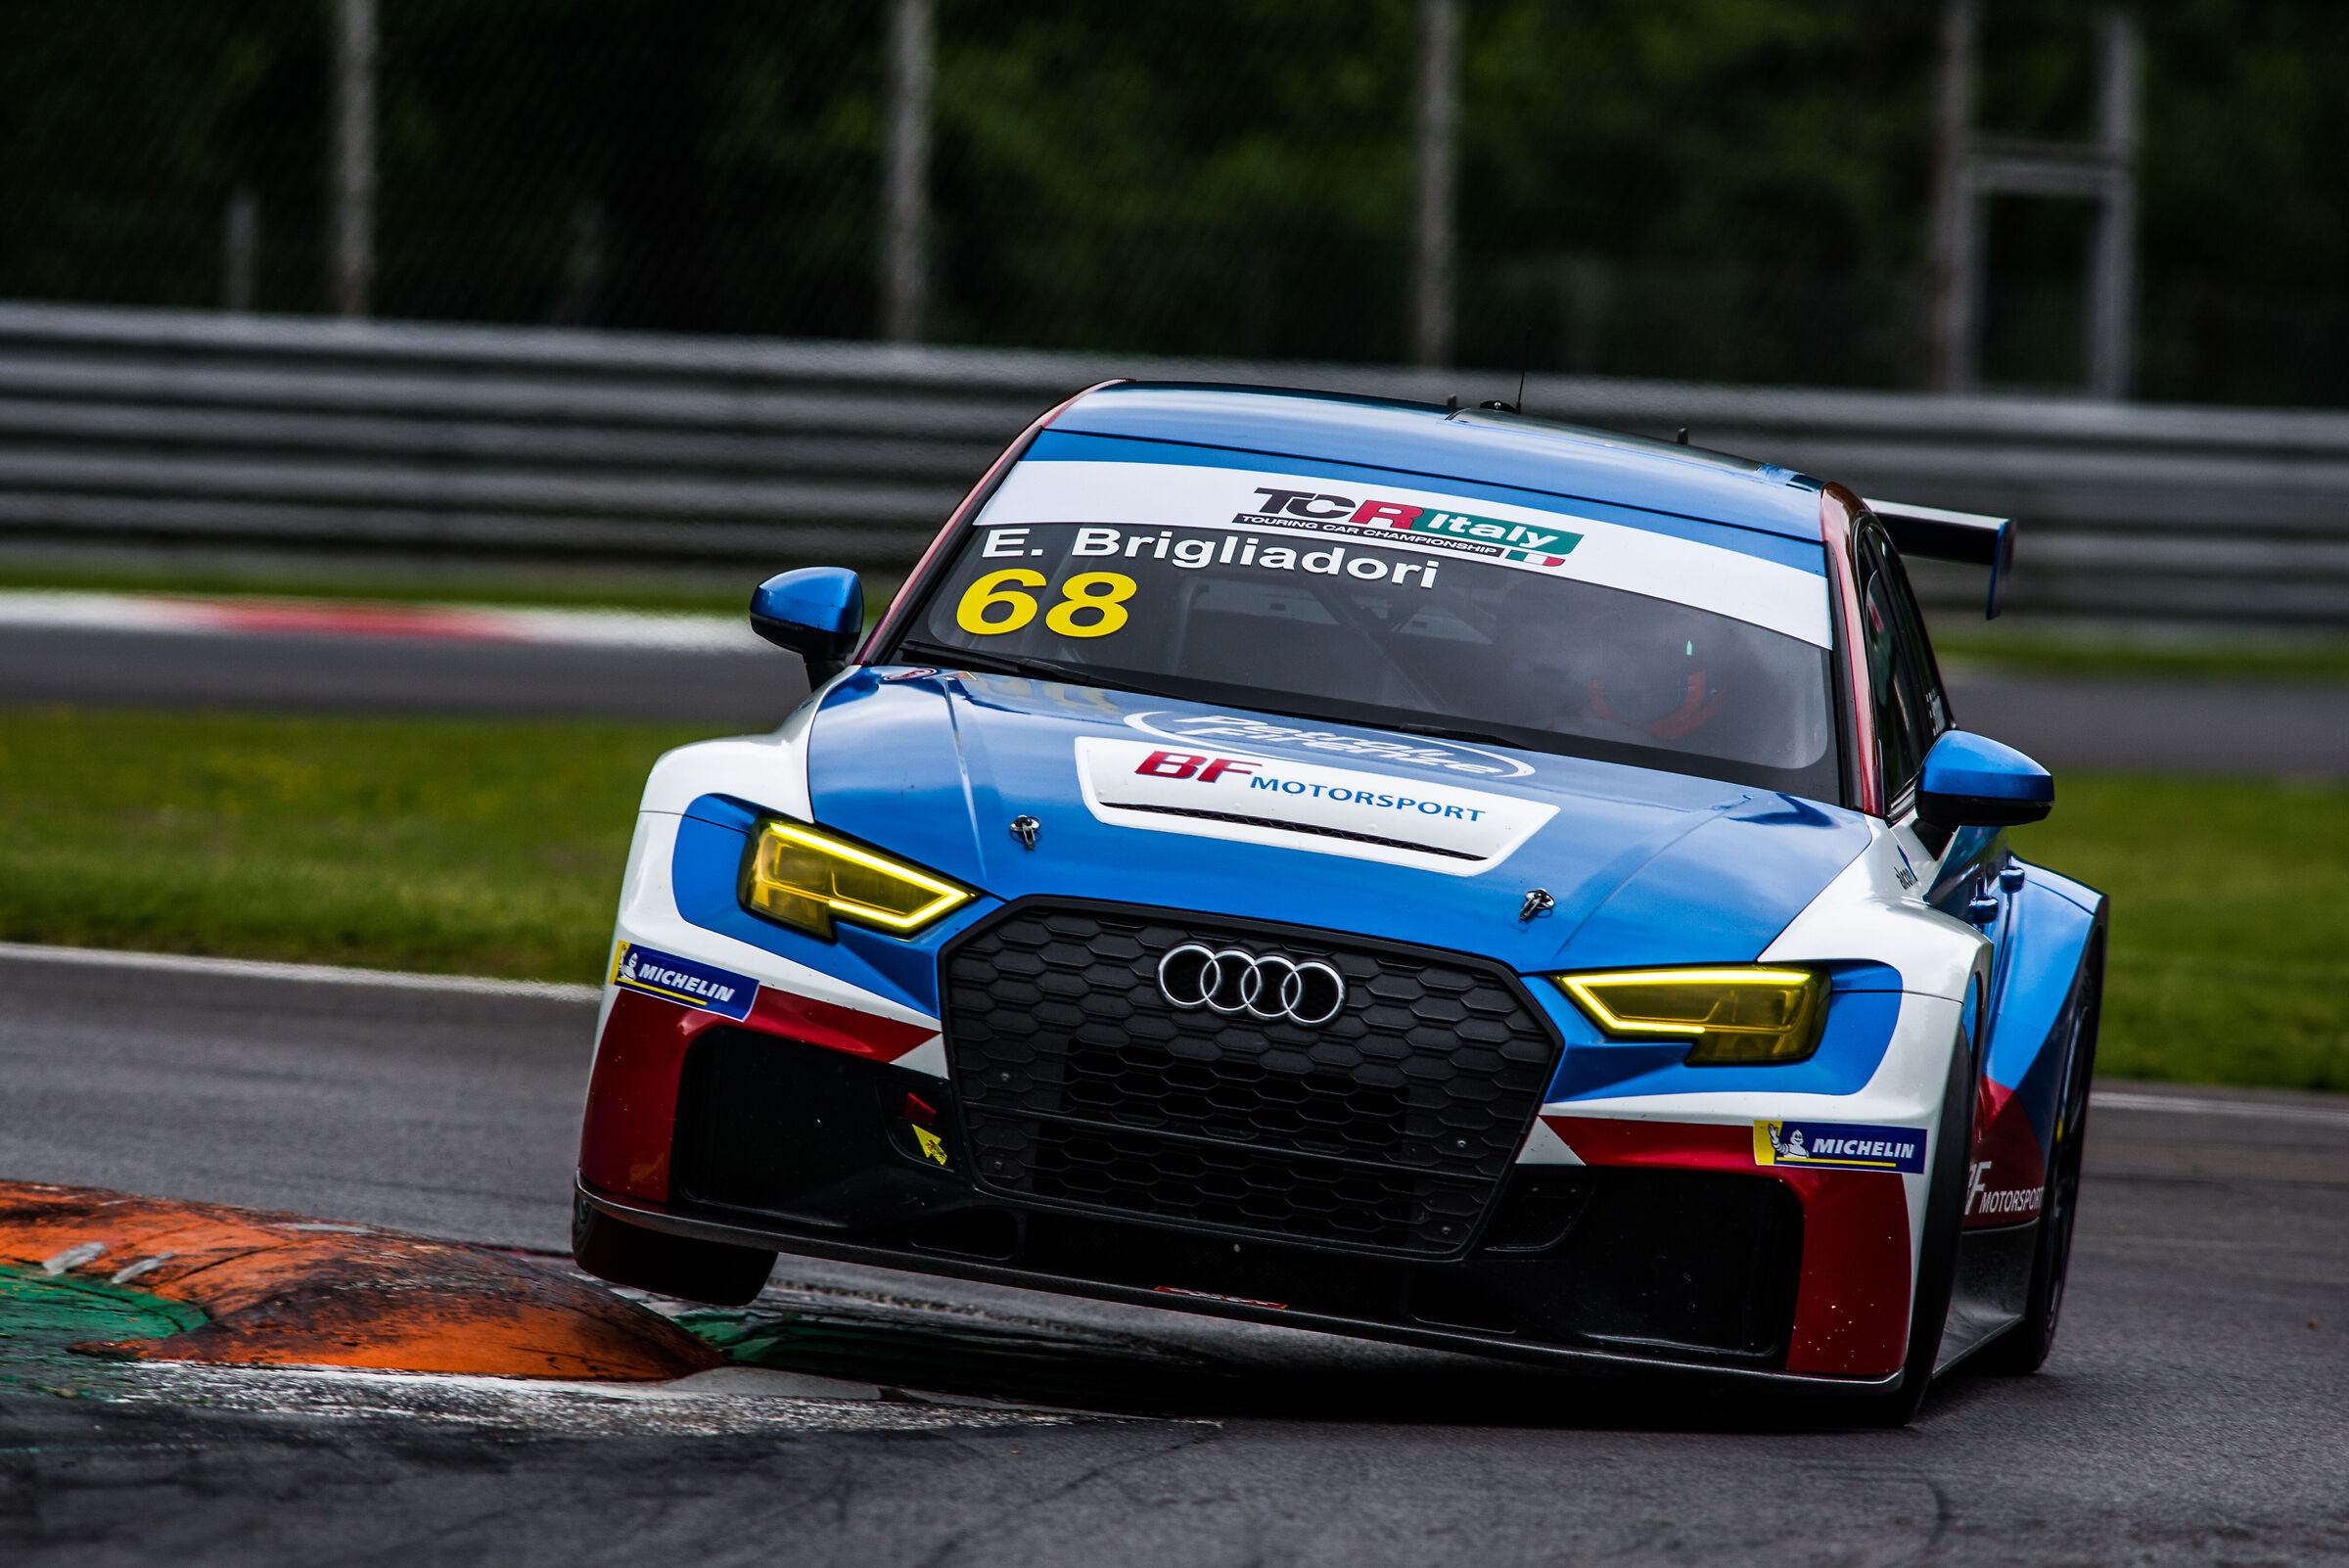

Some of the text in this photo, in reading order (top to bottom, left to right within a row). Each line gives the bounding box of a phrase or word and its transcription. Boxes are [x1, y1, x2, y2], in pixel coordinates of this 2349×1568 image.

[1241, 515, 1498, 554] TOURING CAR CHAMPIONSHIP
[1254, 487, 1558, 548] TCR Italy
[981, 528, 1440, 588] E. Brigliadori
[956, 568, 1137, 638] 68
[1175, 727, 1504, 774] Firenze
[1134, 750, 1487, 822] BF MOTORSPORT
[638, 963, 736, 1002] MICHELIN
[1812, 1138, 1915, 1159] MICHELIN
